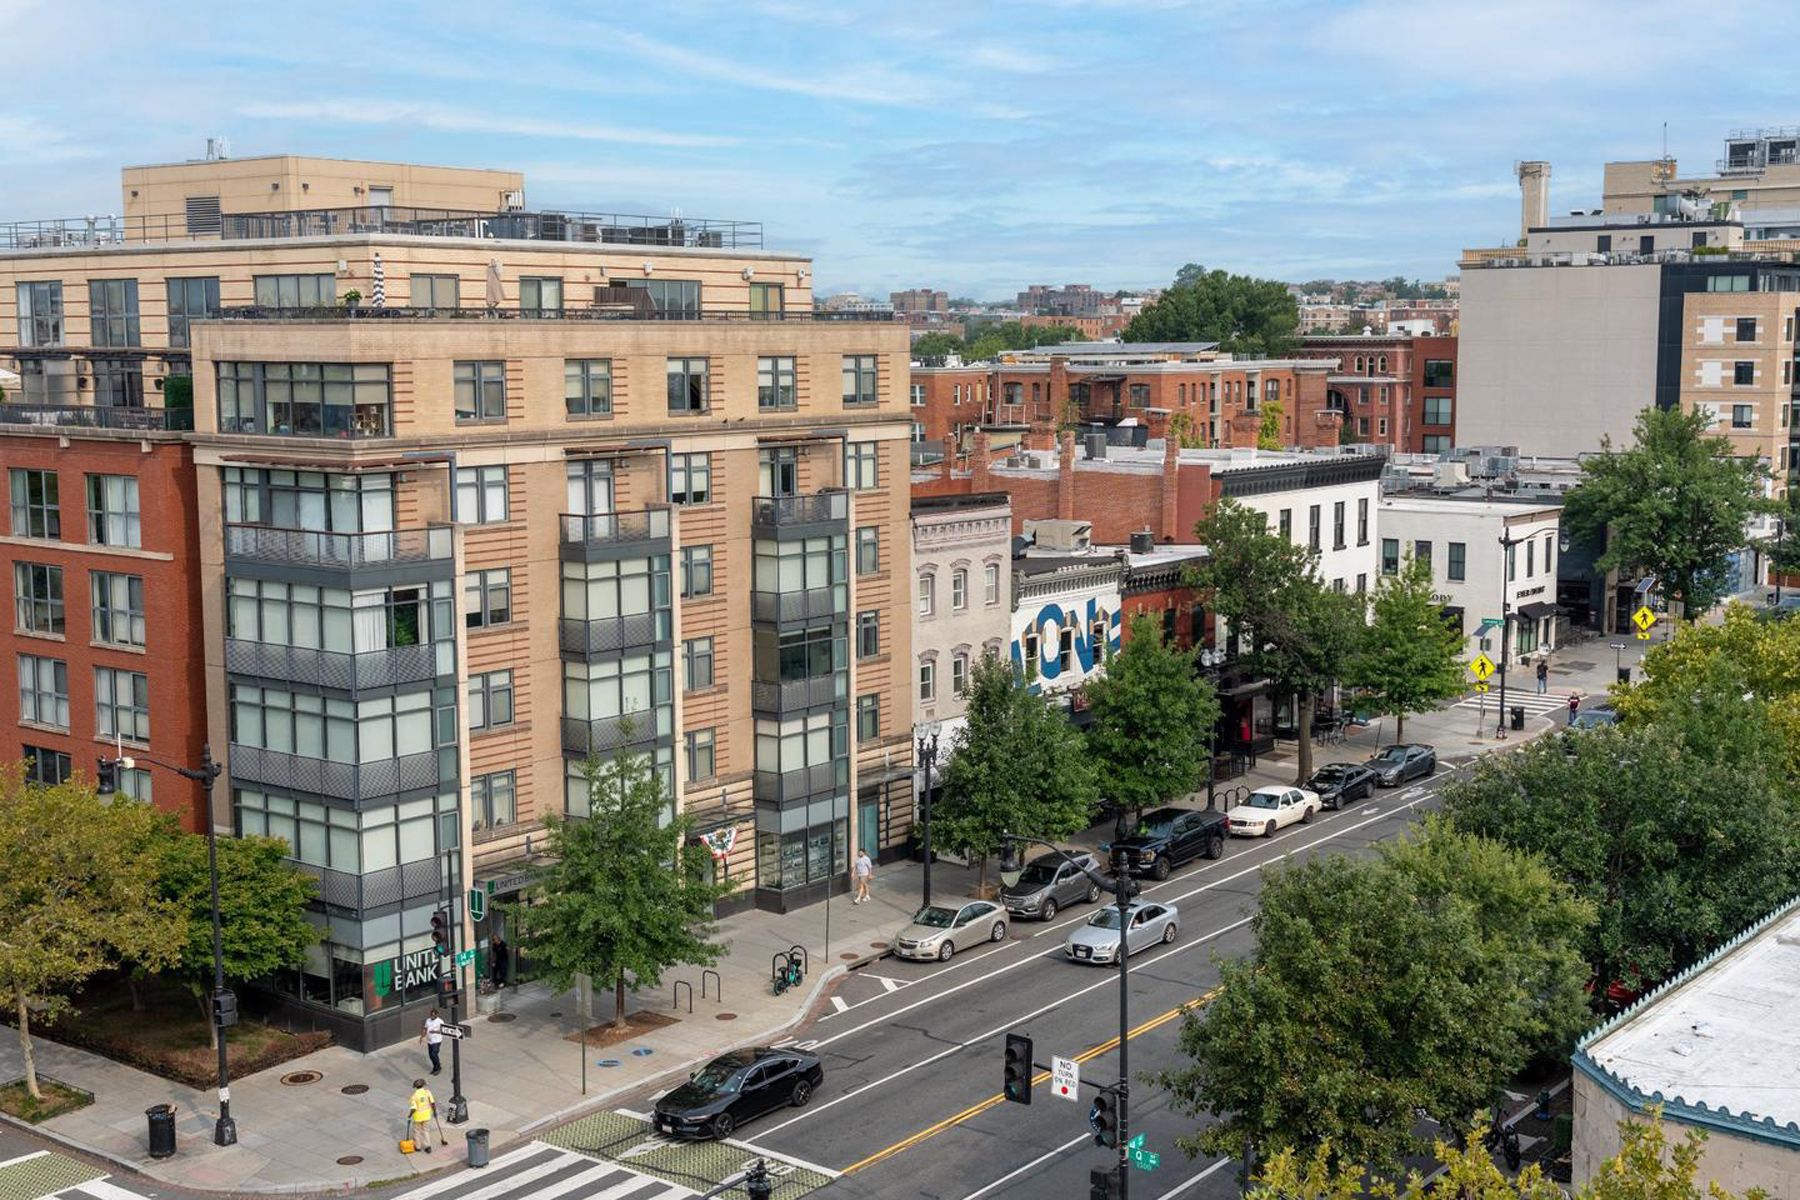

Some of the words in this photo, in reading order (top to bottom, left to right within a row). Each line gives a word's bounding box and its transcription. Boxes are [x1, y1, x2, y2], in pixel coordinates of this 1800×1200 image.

[495, 875, 524, 891] UNITED
[394, 948, 441, 974] UNITE
[394, 964, 438, 991] BANK
[1060, 1060, 1072, 1070] NO
[1058, 1069, 1074, 1079] TURN
[1065, 1078, 1077, 1088] RED
[1135, 1150, 1142, 1161] Q
